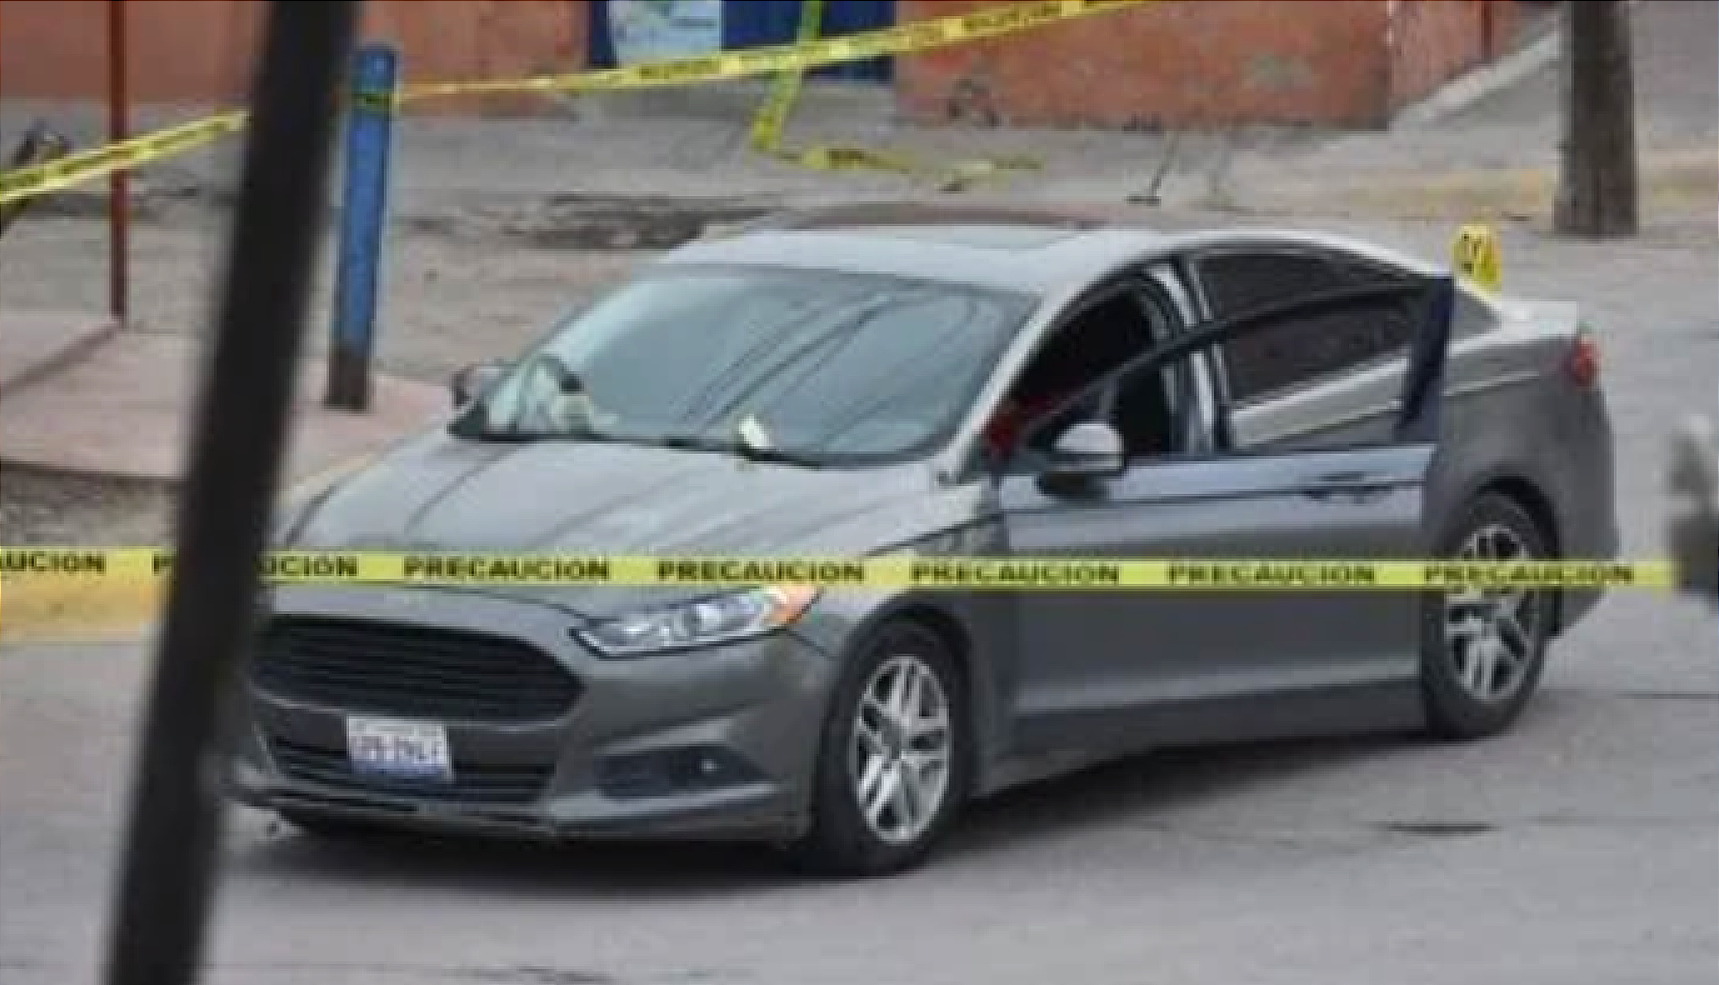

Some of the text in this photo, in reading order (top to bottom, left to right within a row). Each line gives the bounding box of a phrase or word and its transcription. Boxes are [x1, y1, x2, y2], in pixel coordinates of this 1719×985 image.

[404, 555, 610, 581] PRECAUCION
[658, 560, 865, 583] PRECAUCION
[911, 562, 1120, 587] PRECAUCION
